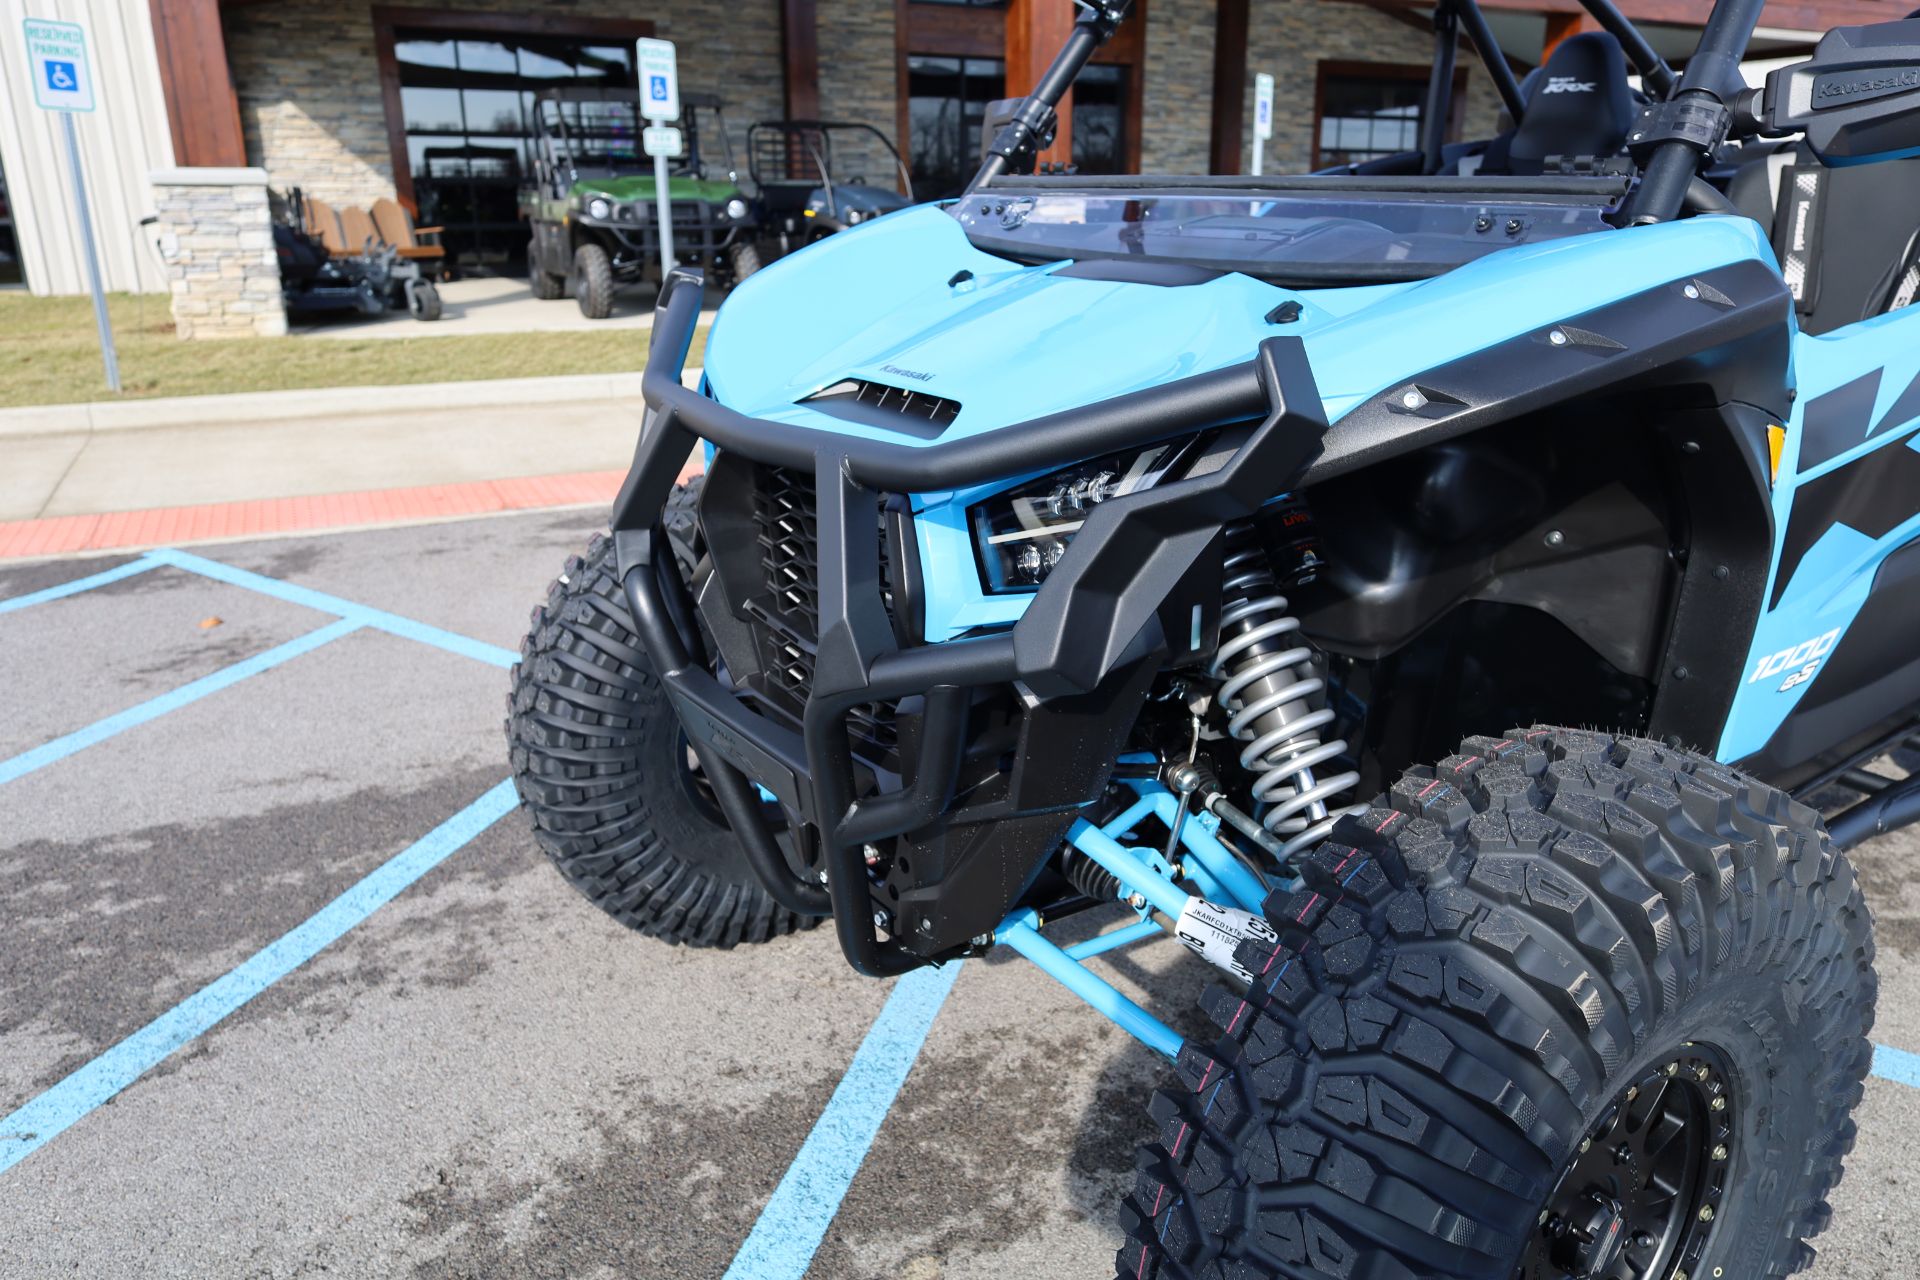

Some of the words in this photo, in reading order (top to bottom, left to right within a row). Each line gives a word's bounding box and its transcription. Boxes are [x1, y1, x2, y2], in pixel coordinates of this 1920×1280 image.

[27, 27, 82, 44] RESERVED
[33, 42, 80, 59] PARKING
[1542, 82, 1597, 94] KRX
[1817, 69, 1918, 99] Kawasaki
[1793, 201, 1810, 251] Kawasaki
[879, 364, 936, 382] Kawasaki
[1747, 626, 1841, 684] 1000
